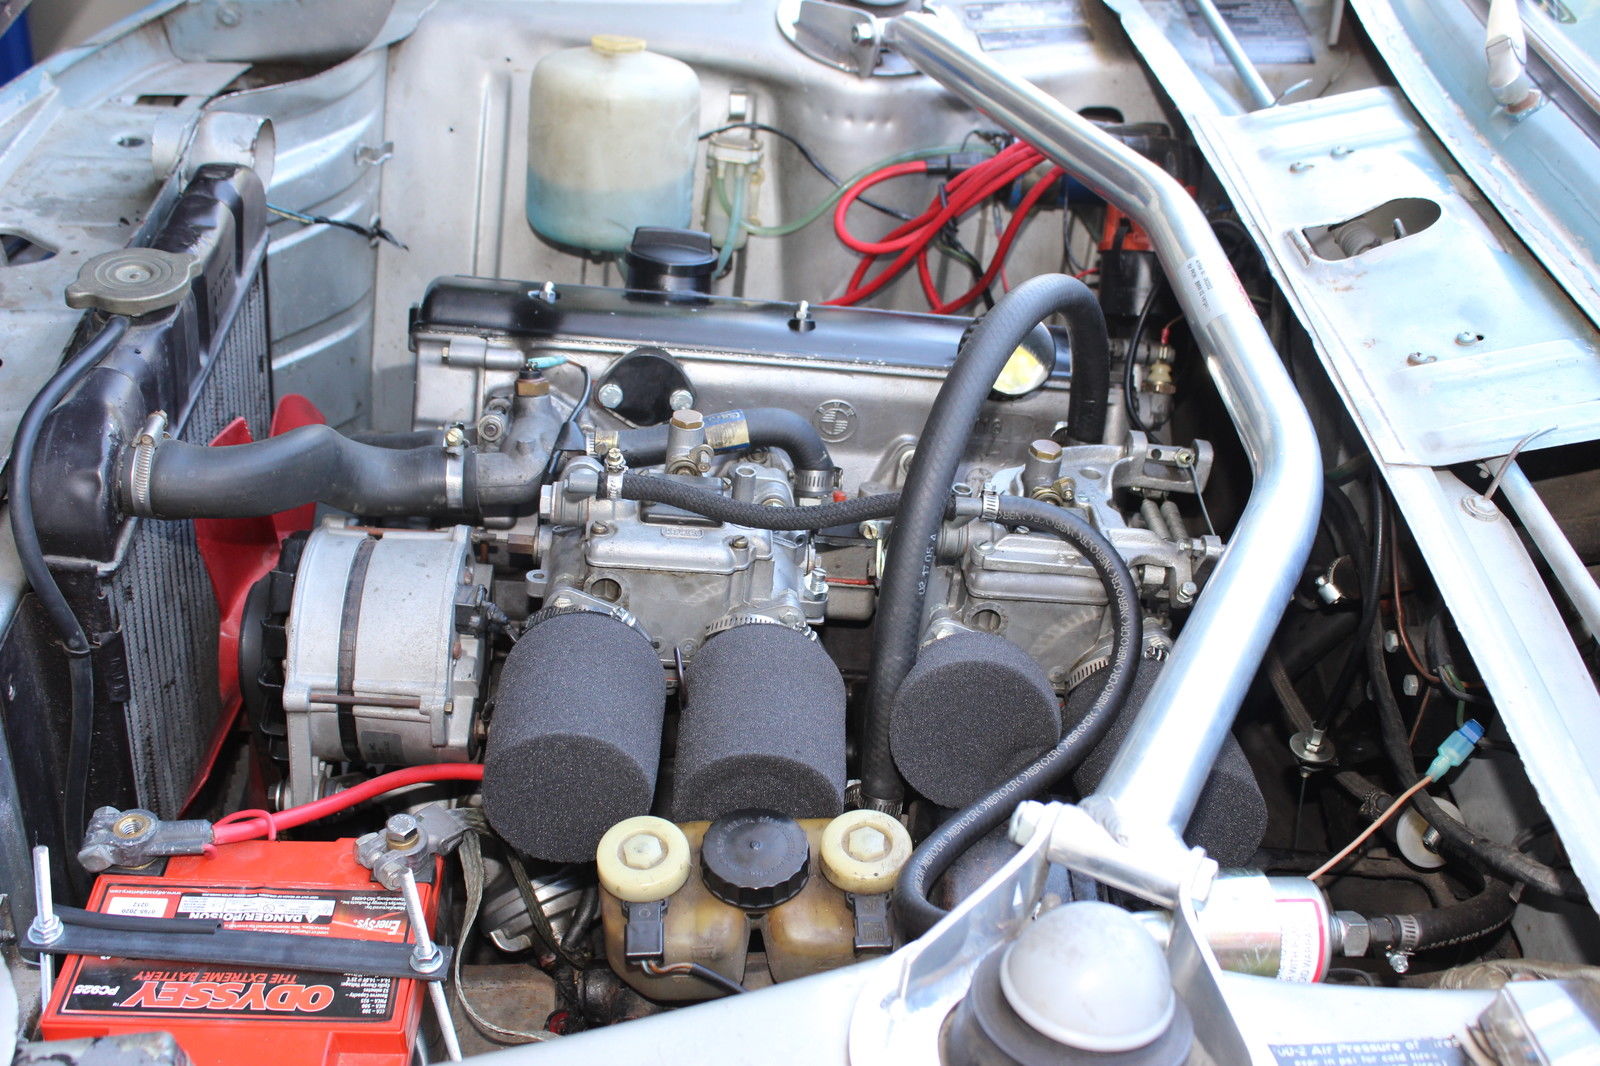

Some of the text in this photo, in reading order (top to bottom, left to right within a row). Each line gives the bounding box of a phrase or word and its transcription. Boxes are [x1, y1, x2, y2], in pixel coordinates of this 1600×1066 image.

[132, 969, 297, 985] THE EXTREME BATTERY
[73, 984, 120, 996] PC925
[120, 979, 334, 1012] ODYSSEY
[1311, 1044, 1332, 1055] Air
[1336, 1042, 1400, 1055] Pressure
